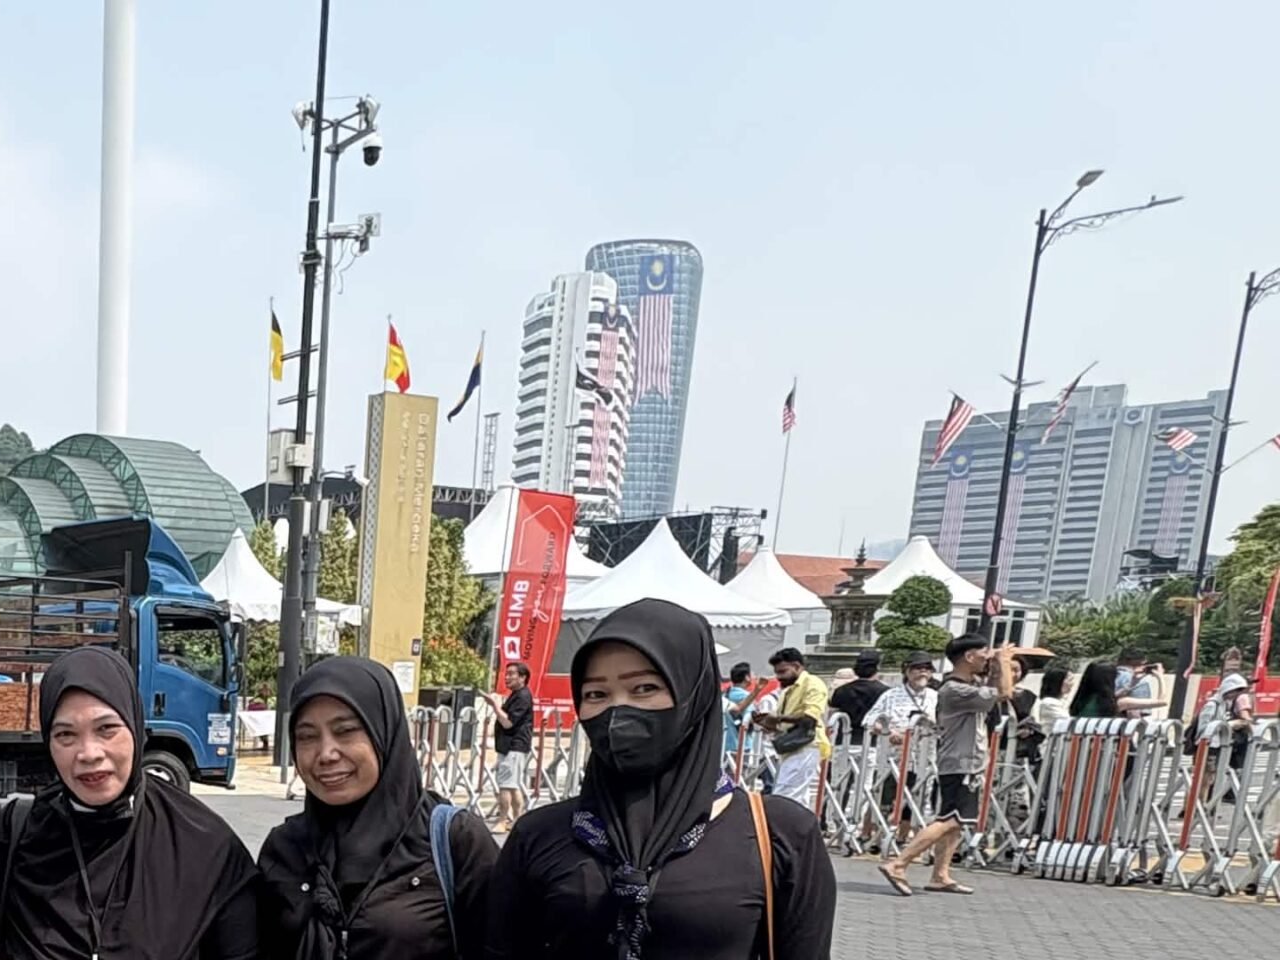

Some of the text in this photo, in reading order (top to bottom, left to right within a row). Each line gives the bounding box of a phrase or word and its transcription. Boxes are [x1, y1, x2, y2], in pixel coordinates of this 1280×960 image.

[410, 412, 430, 553] Dataran Merdeka
[506, 580, 530, 632] CIMB
[523, 616, 538, 660] MOVING
[539, 531, 556, 585] FORWARD
